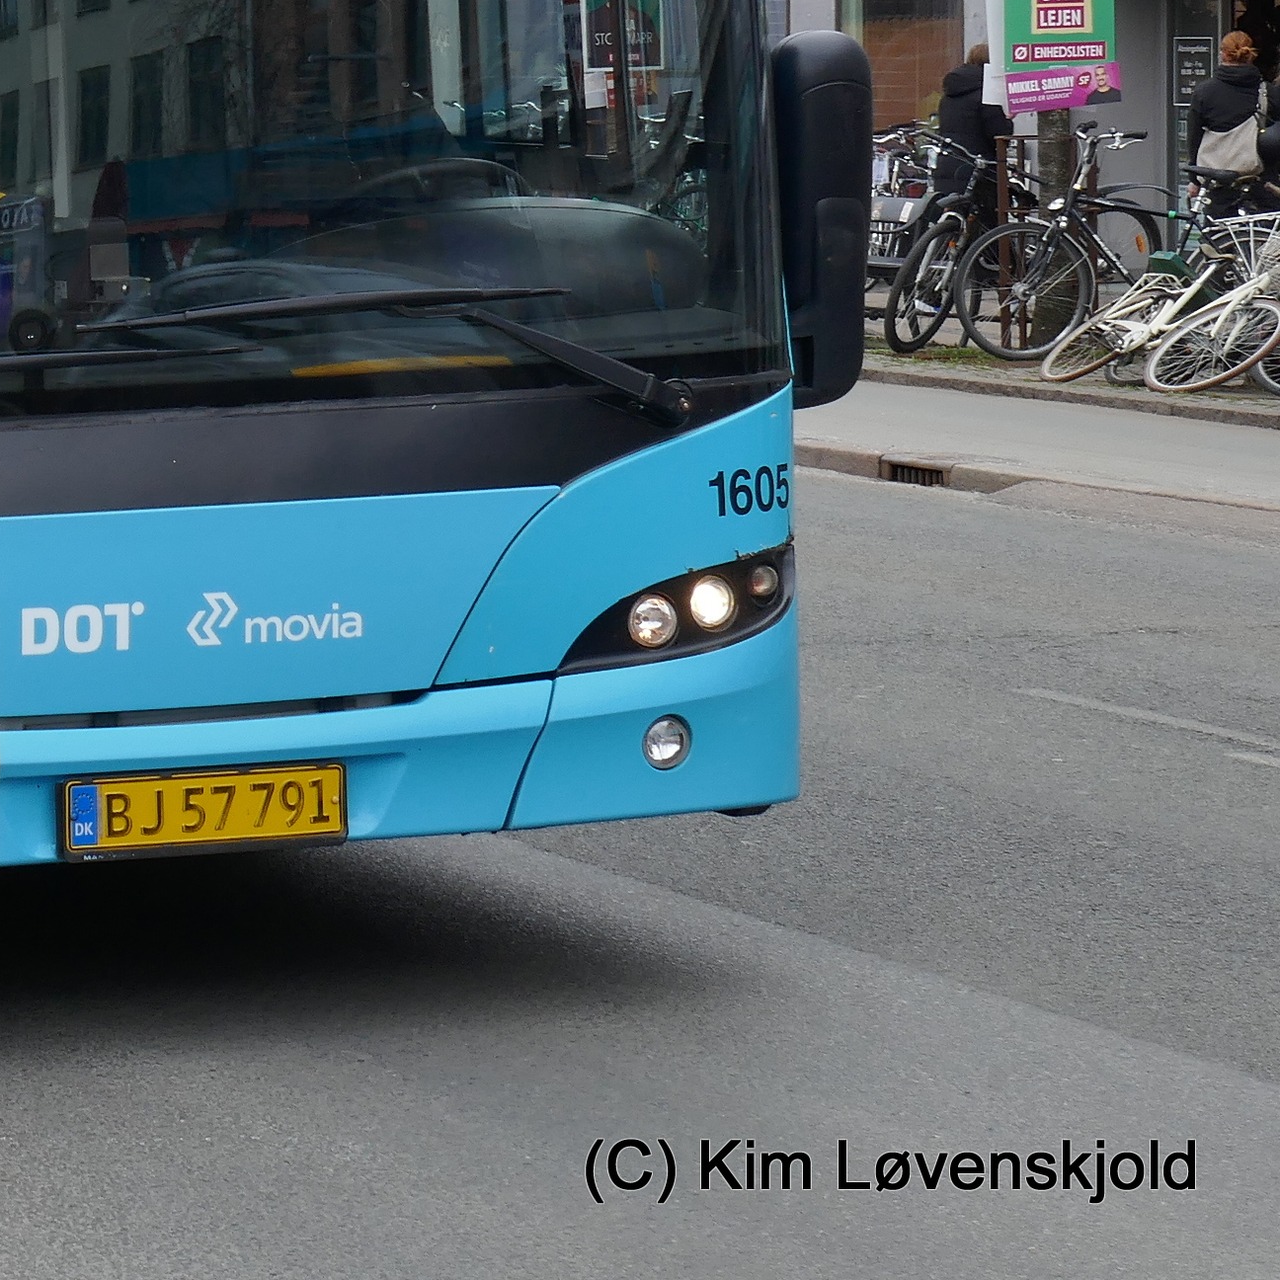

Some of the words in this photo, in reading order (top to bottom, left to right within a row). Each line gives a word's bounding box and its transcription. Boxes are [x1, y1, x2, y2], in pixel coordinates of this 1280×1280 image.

[1040, 9, 1081, 27] LEJEN
[1015, 46, 1027, 60] Ø
[1034, 45, 1104, 58] ENHEDSLISTEN
[1008, 79, 1040, 94] MIKKEL
[1042, 76, 1074, 90] SAMMY
[1078, 75, 1090, 85] SF
[709, 463, 789, 516] 1605
[22, 601, 144, 655] DOT
[245, 603, 362, 643] movia
[105, 789, 164, 838] BJ
[182, 785, 236, 833] 57
[250, 778, 331, 828] 791
[75, 822, 94, 836] DK
